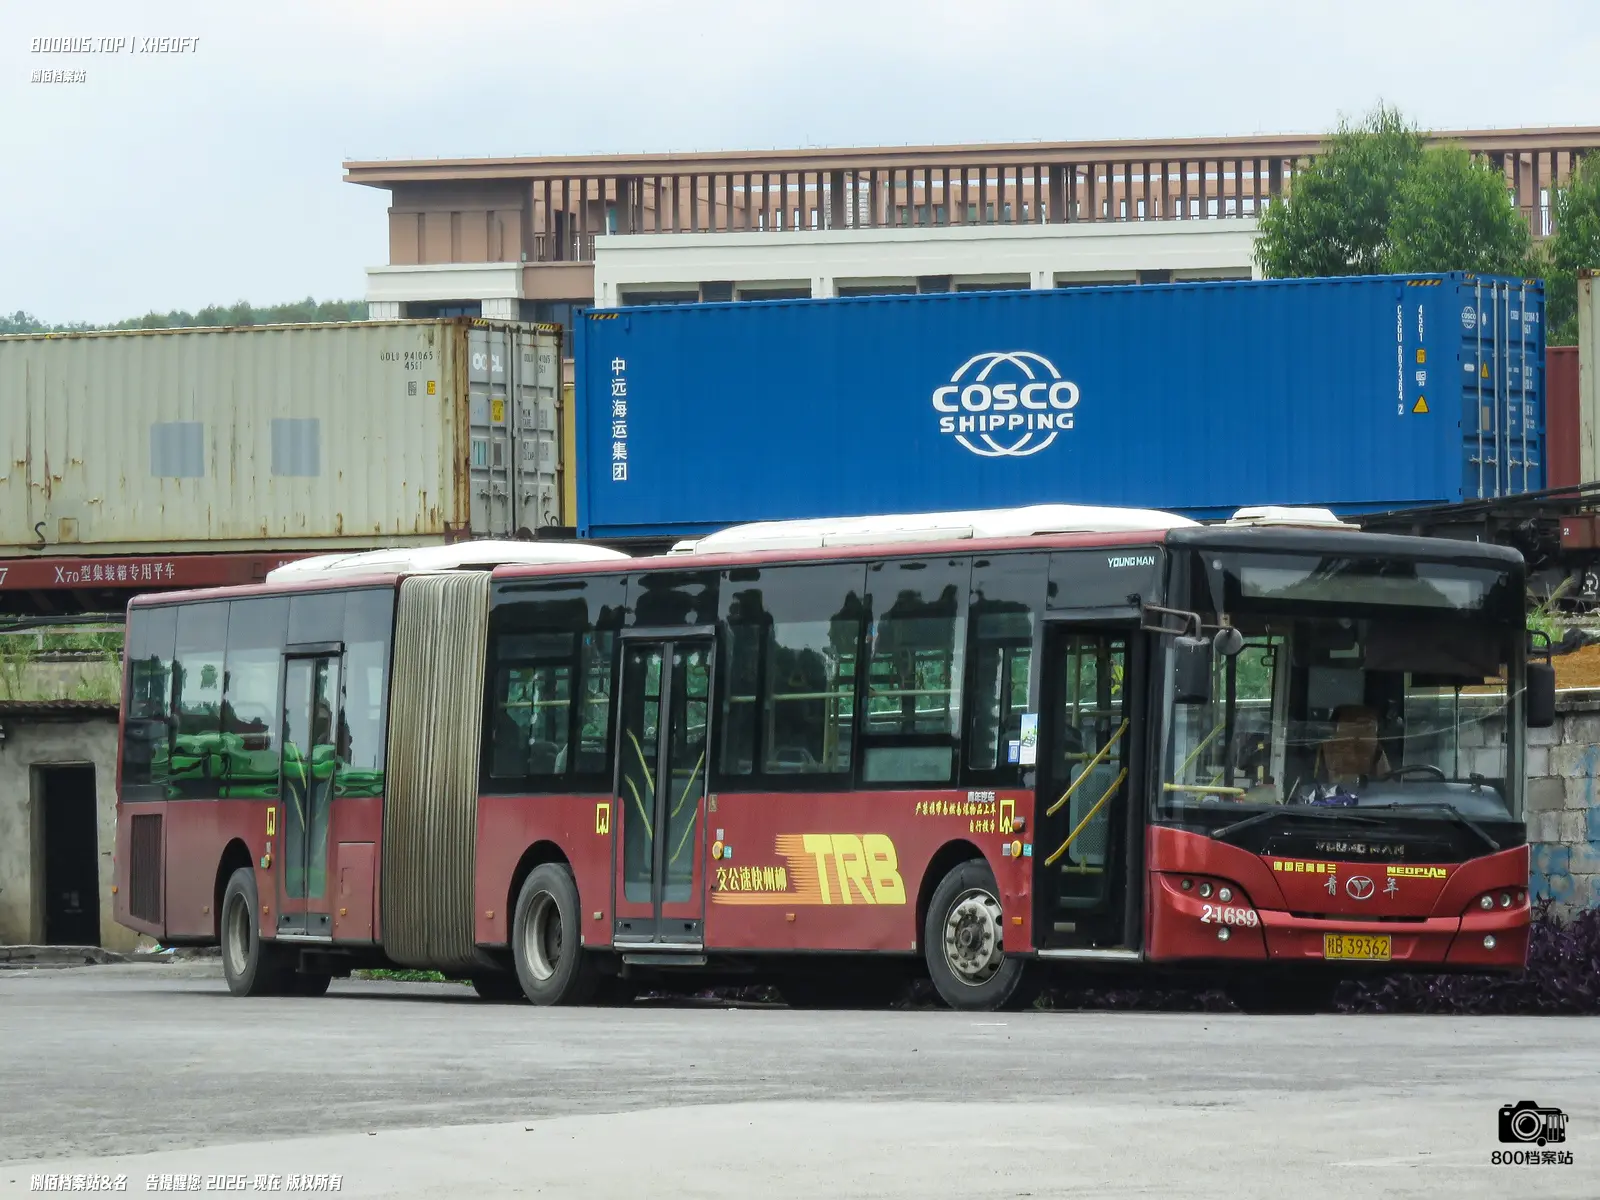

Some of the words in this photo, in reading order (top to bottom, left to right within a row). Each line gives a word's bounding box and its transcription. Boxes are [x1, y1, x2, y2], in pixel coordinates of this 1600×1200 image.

[932, 381, 1080, 413] COSCO
[611, 357, 628, 481] 中远海运集团
[939, 412, 1074, 433] SHIPPING
[1563, 527, 1570, 536] 2
[1107, 557, 1136, 567] YOUNG
[1136, 556, 1155, 566] MAN
[802, 833, 907, 905] TRB
[1387, 866, 1446, 878] NEOPLAN
